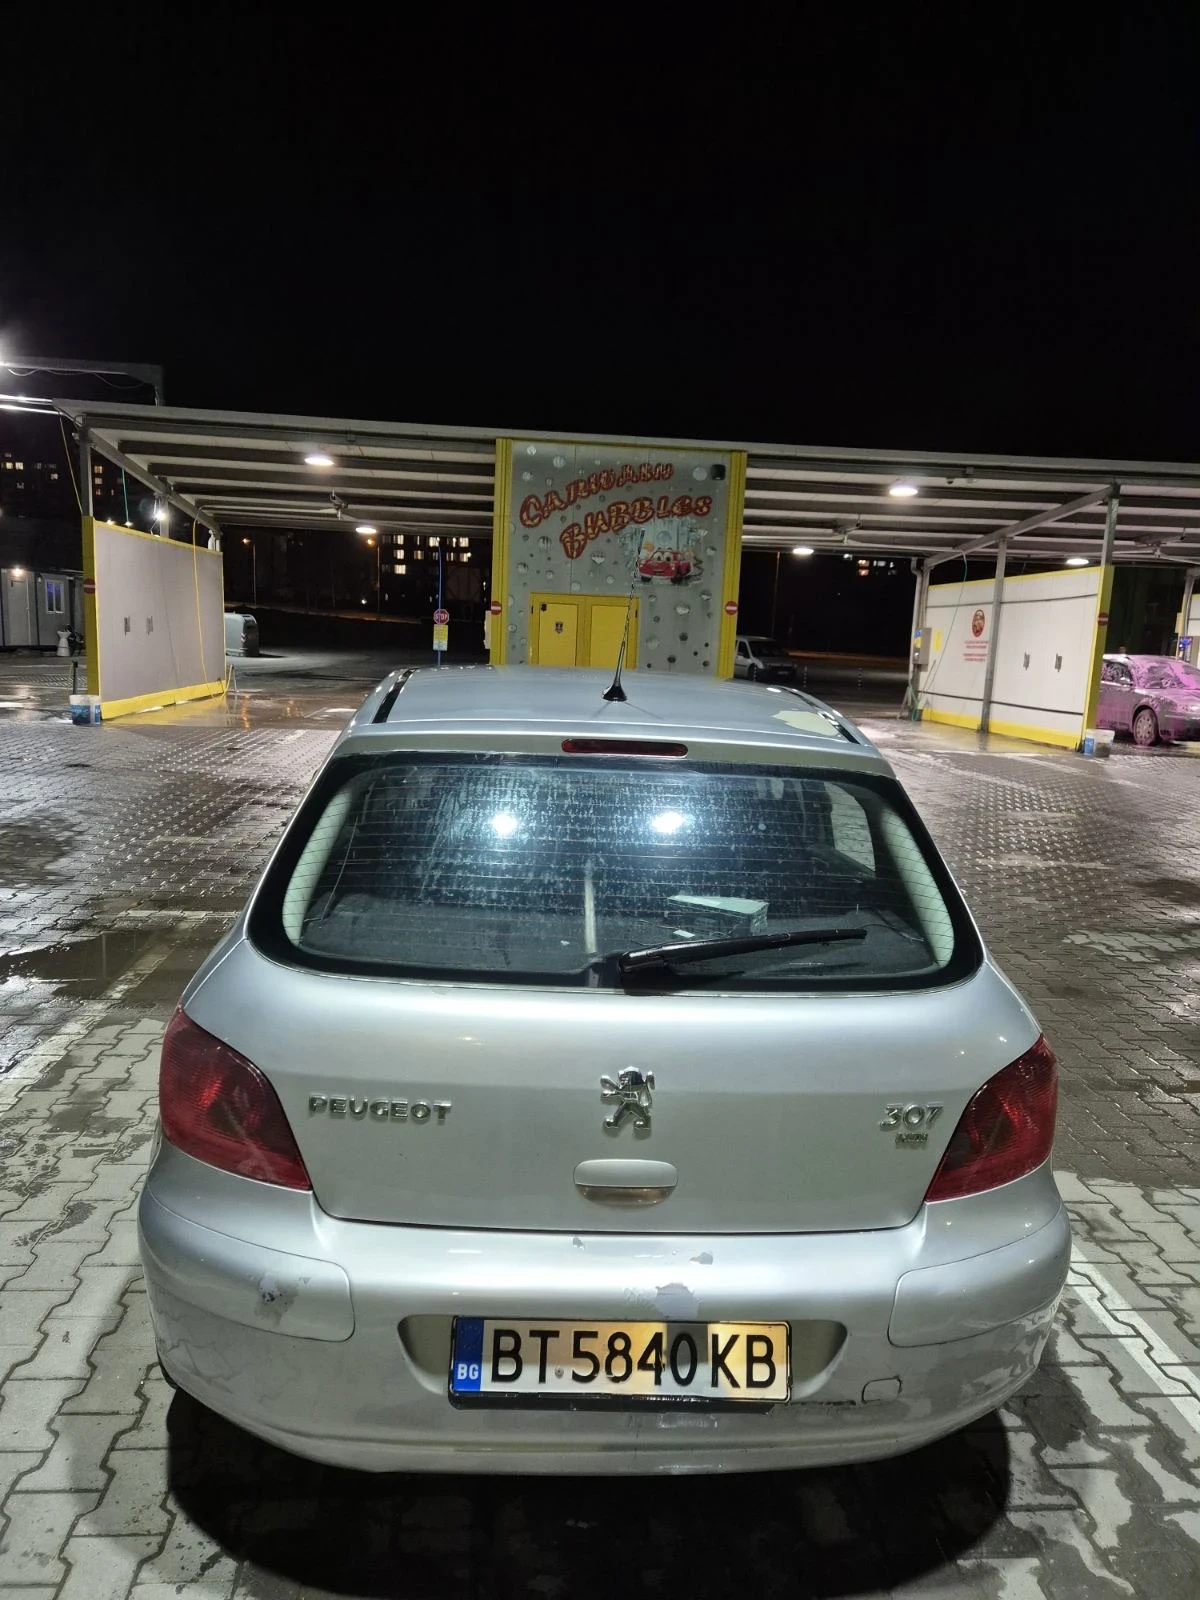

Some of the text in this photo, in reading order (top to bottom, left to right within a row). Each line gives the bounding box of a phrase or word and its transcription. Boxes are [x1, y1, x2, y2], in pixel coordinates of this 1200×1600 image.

[308, 1093, 452, 1125] PEUGEOT
[879, 1102, 944, 1131] 307
[457, 1363, 479, 1380] BG
[491, 1329, 776, 1389] BT 5840 KB
